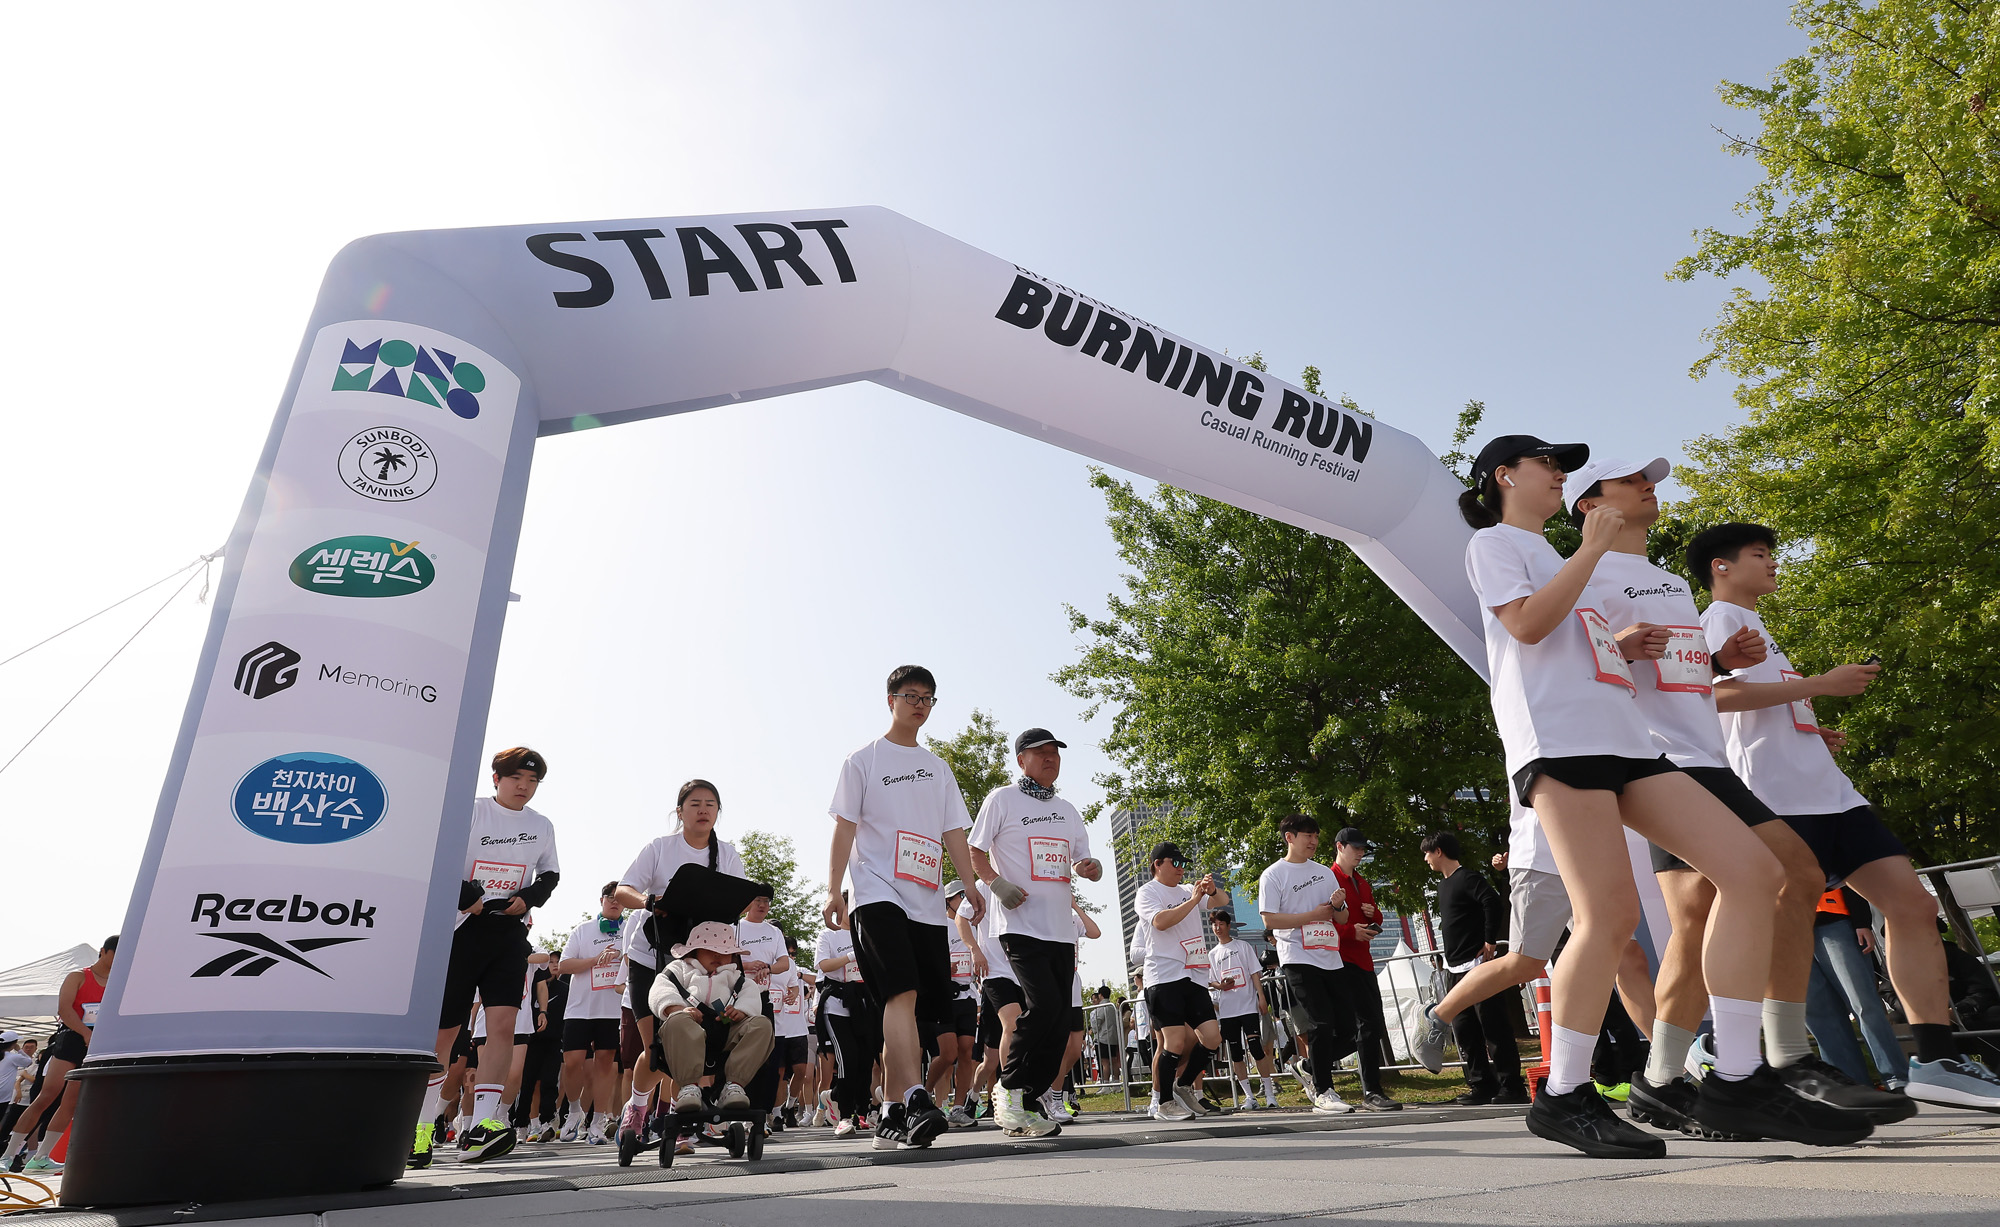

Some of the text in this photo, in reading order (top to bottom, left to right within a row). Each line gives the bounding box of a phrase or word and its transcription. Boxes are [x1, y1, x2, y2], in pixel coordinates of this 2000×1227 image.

[525, 219, 858, 309] START
[994, 274, 1373, 463] BURNING RUN
[356, 429, 430, 460] SUNBODY
[1200, 410, 1361, 483] Casual Running Festival
[352, 475, 415, 498] TANNING
[306, 547, 422, 585] 셀렉스
[1624, 583, 1684, 598] Burning Run
[1663, 649, 1709, 666] M 1490
[318, 663, 437, 703] MemorinG
[271, 769, 356, 795] 천지차이
[881, 769, 934, 786] Burning Run
[252, 790, 364, 830] 백산수
[1021, 816, 1052, 826] Burning
[480, 832, 538, 846] Burning Run
[902, 849, 911, 857] M
[912, 851, 938, 868] 1236
[1045, 853, 1067, 864] 2074
[485, 879, 518, 891] 2452
[190, 893, 377, 928] Reebok
